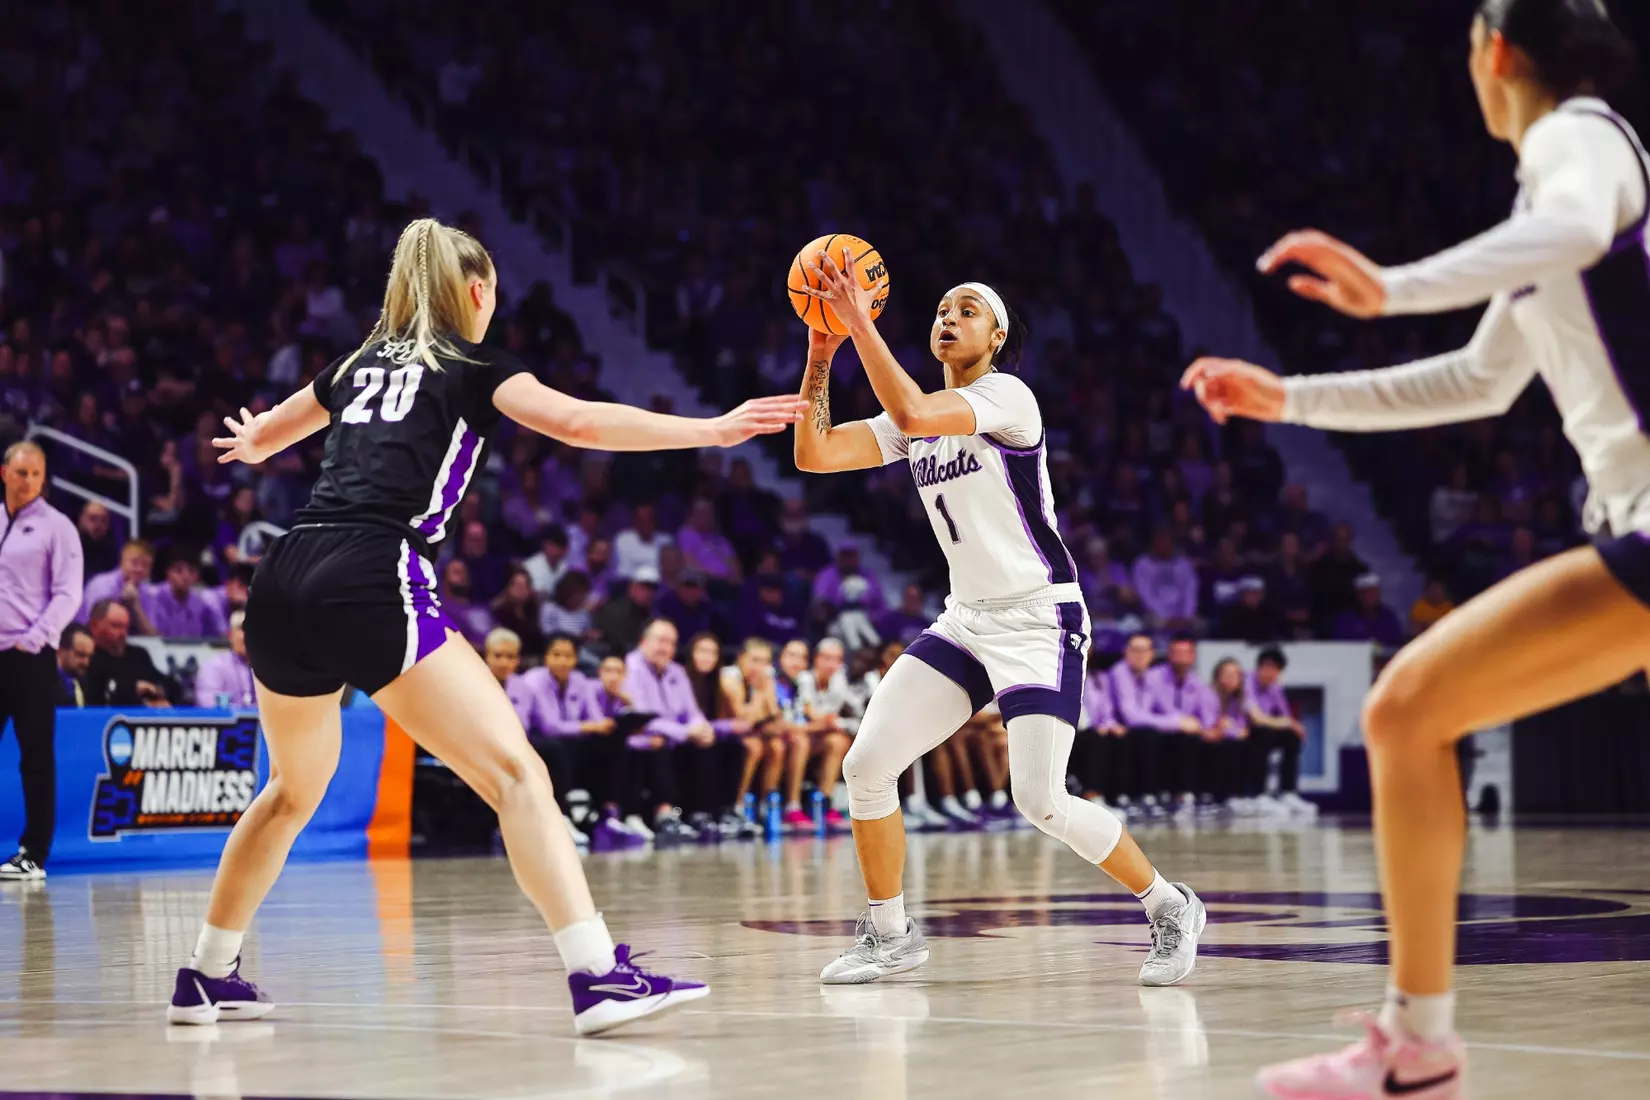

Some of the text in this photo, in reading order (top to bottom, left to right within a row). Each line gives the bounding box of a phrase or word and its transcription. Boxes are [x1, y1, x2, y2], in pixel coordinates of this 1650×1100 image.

[341, 364, 424, 424] 20
[935, 493, 961, 545] 1
[131, 727, 218, 770] MARCH
[141, 769, 256, 814] MADNESS
